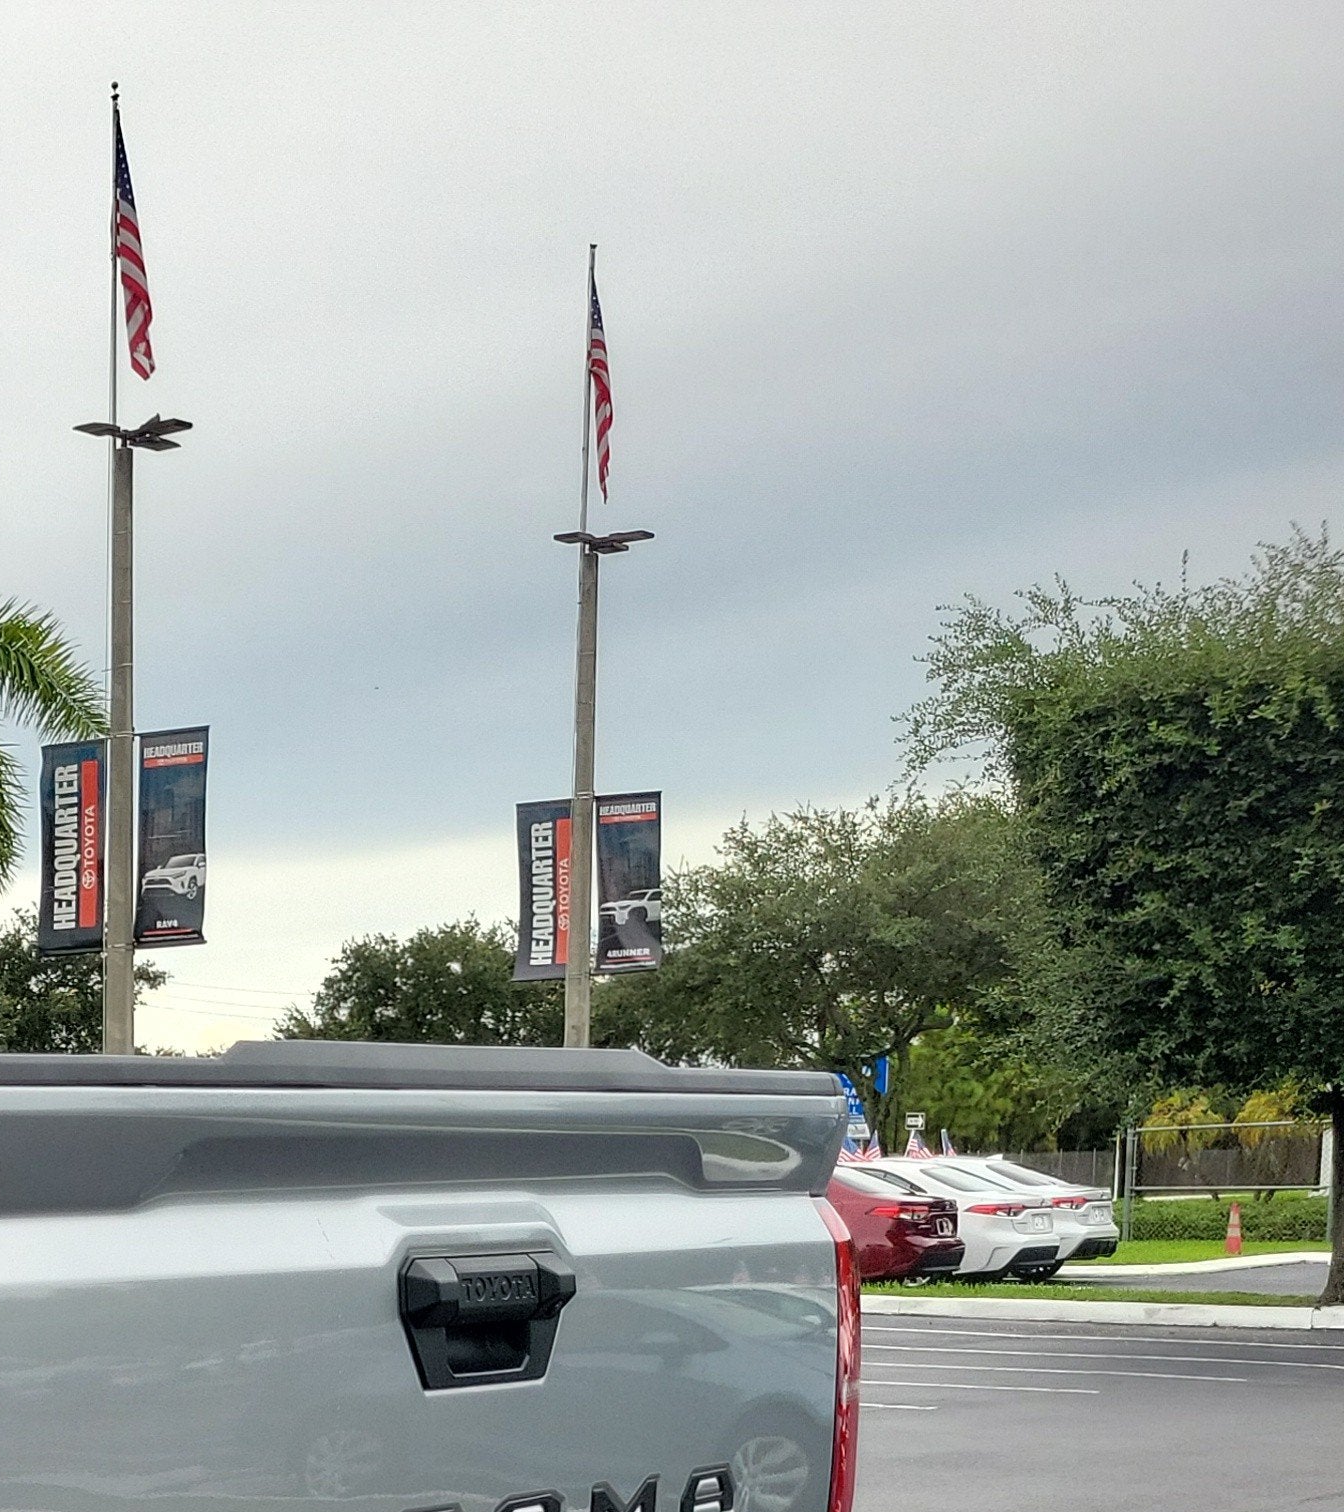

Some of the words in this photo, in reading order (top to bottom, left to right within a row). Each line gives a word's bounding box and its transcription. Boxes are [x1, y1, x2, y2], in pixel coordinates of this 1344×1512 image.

[143, 741, 204, 759] HEADQUARTER
[83, 805, 96, 867] TOYOTA
[599, 802, 657, 816] HEADQUARTER
[53, 763, 81, 931] HEADQUARTER
[529, 821, 556, 966] HEADQUARTER
[559, 858, 570, 913] TOYOTA
[462, 1274, 537, 1302] TOYOTA
